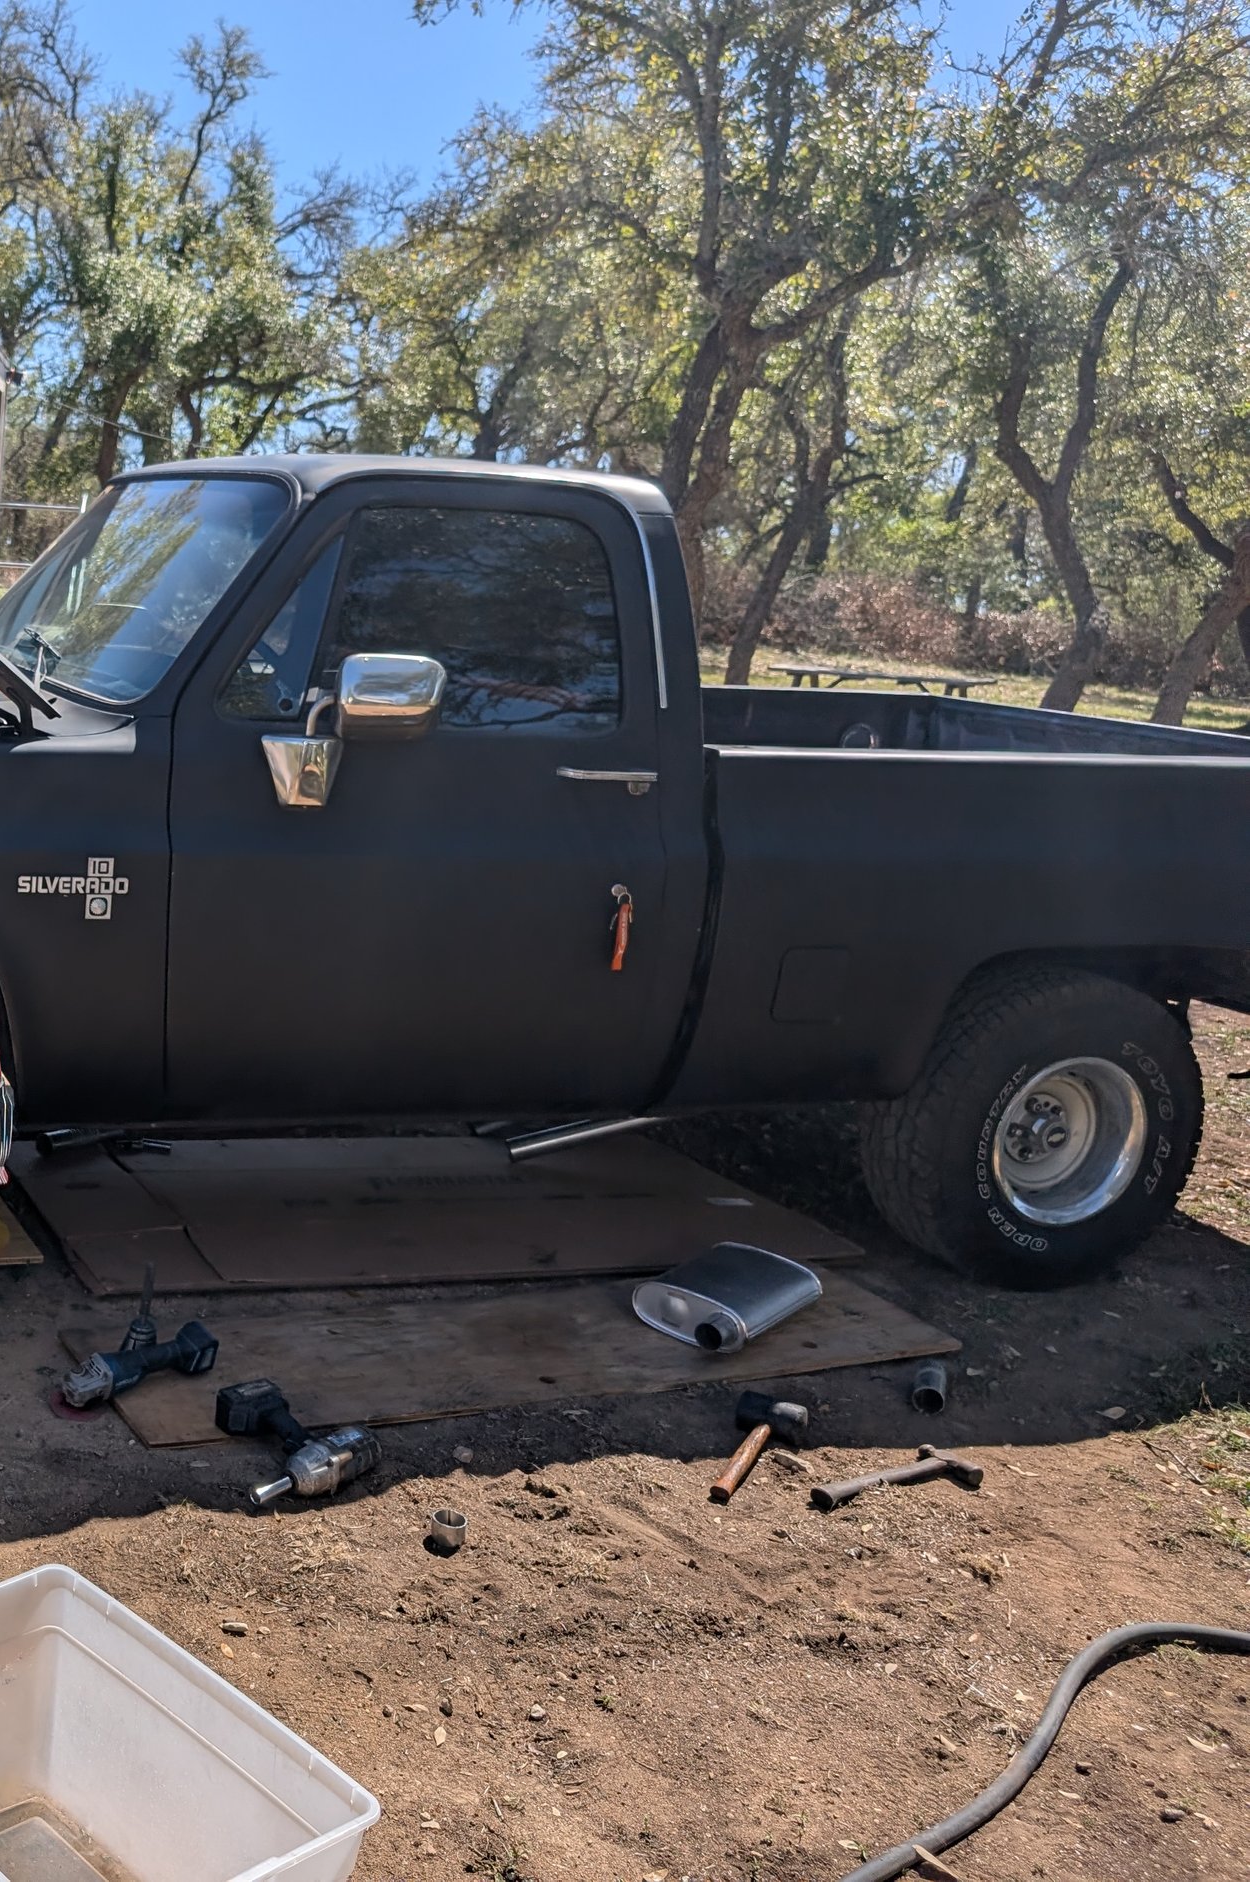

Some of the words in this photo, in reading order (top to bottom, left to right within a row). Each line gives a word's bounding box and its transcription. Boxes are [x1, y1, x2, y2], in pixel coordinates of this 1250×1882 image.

[91, 859, 111, 875] 10
[17, 875, 130, 895] SILVERADO
[1120, 1041, 1174, 1121] TOYO
[987, 1206, 1048, 1251] OPEN
